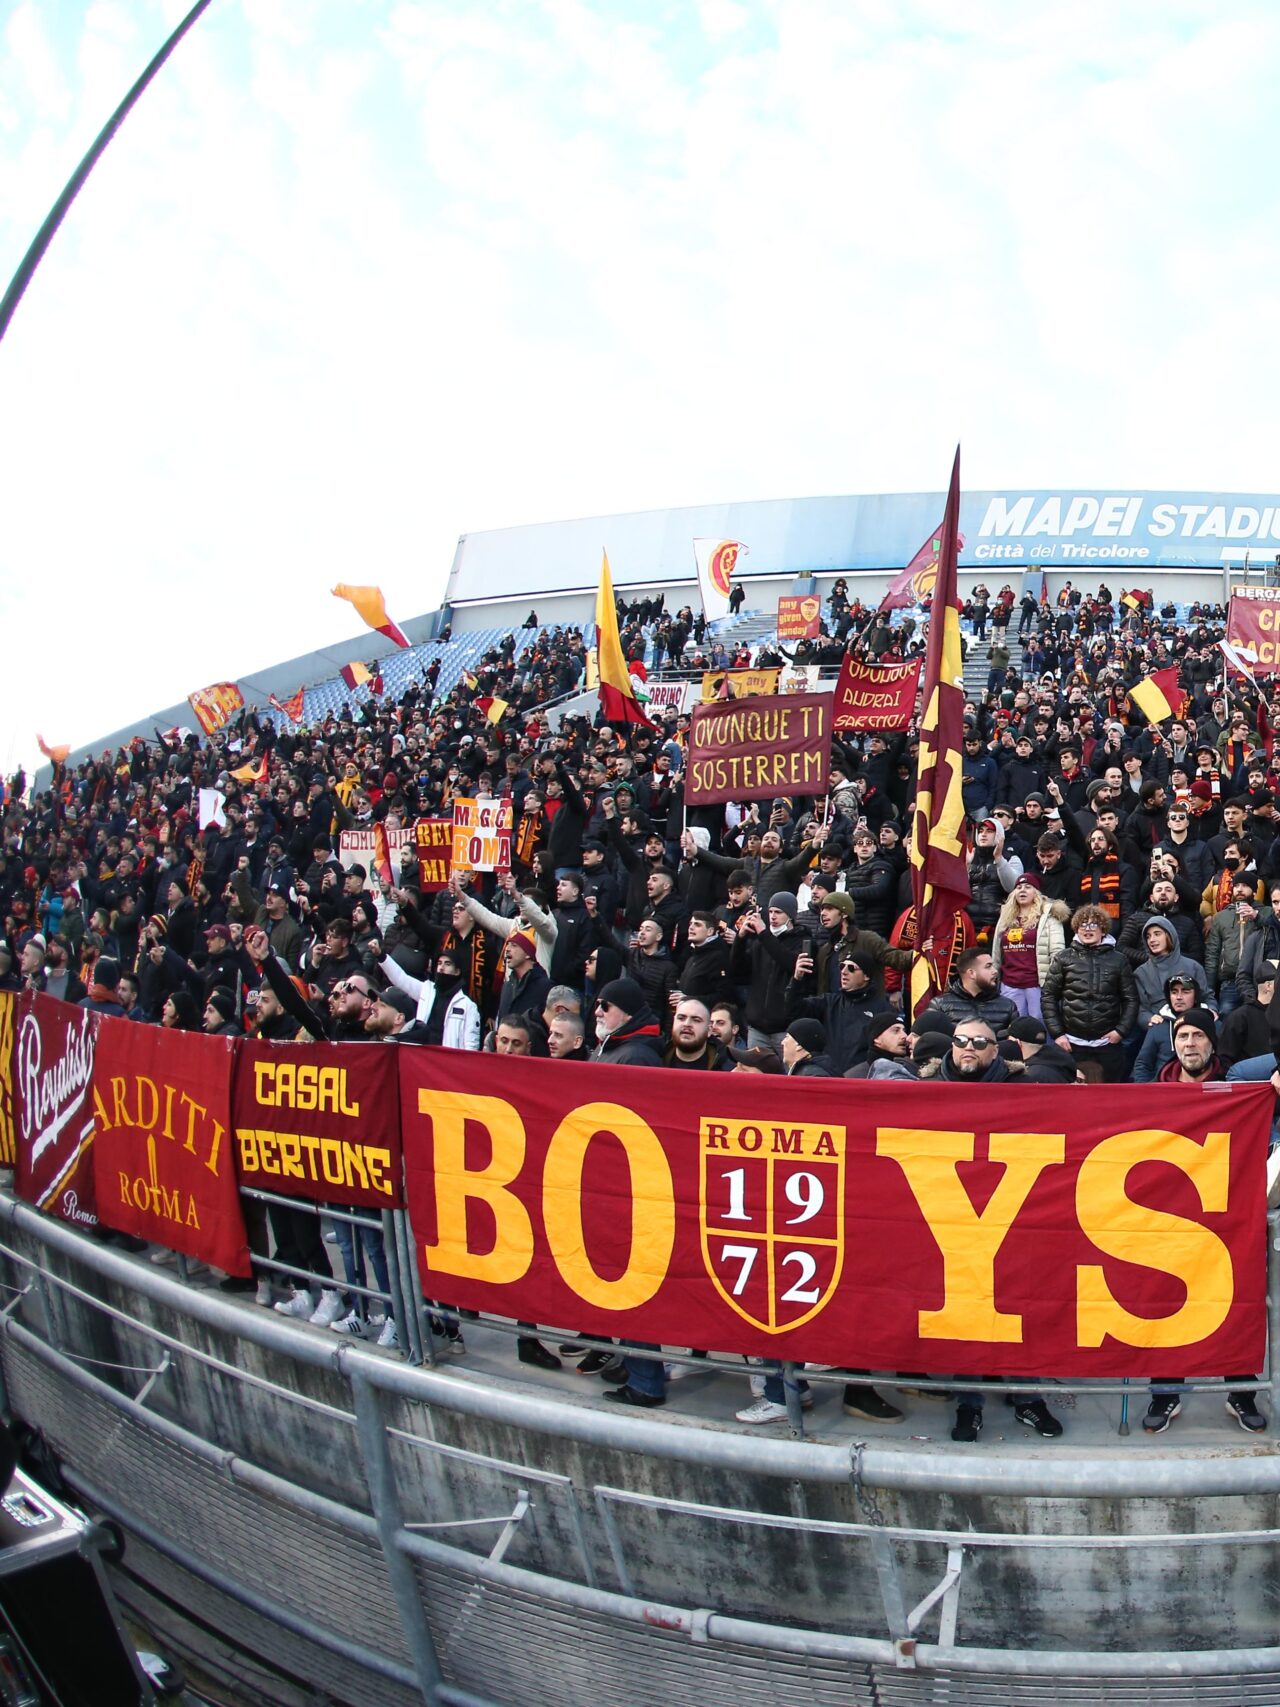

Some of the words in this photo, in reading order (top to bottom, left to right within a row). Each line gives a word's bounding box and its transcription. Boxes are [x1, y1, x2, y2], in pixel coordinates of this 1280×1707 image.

[978, 497, 1144, 537] MAPEI
[974, 542, 1024, 558] Città
[1030, 543, 1056, 558] del
[1061, 543, 1150, 559] Tricolore
[695, 709, 792, 748] OVUNQUE
[802, 706, 824, 738] TI
[692, 751, 822, 793] SOSTERREM
[454, 805, 514, 829] MAGICA
[453, 834, 512, 867] ROMA
[253, 1061, 360, 1117] CASAL
[93, 1075, 226, 1177] ARDITI
[706, 1123, 839, 1158] ROMA
[236, 1128, 393, 1196] BERTONE
[63, 1190, 98, 1225] Roma
[119, 1171, 201, 1231] ROMA
